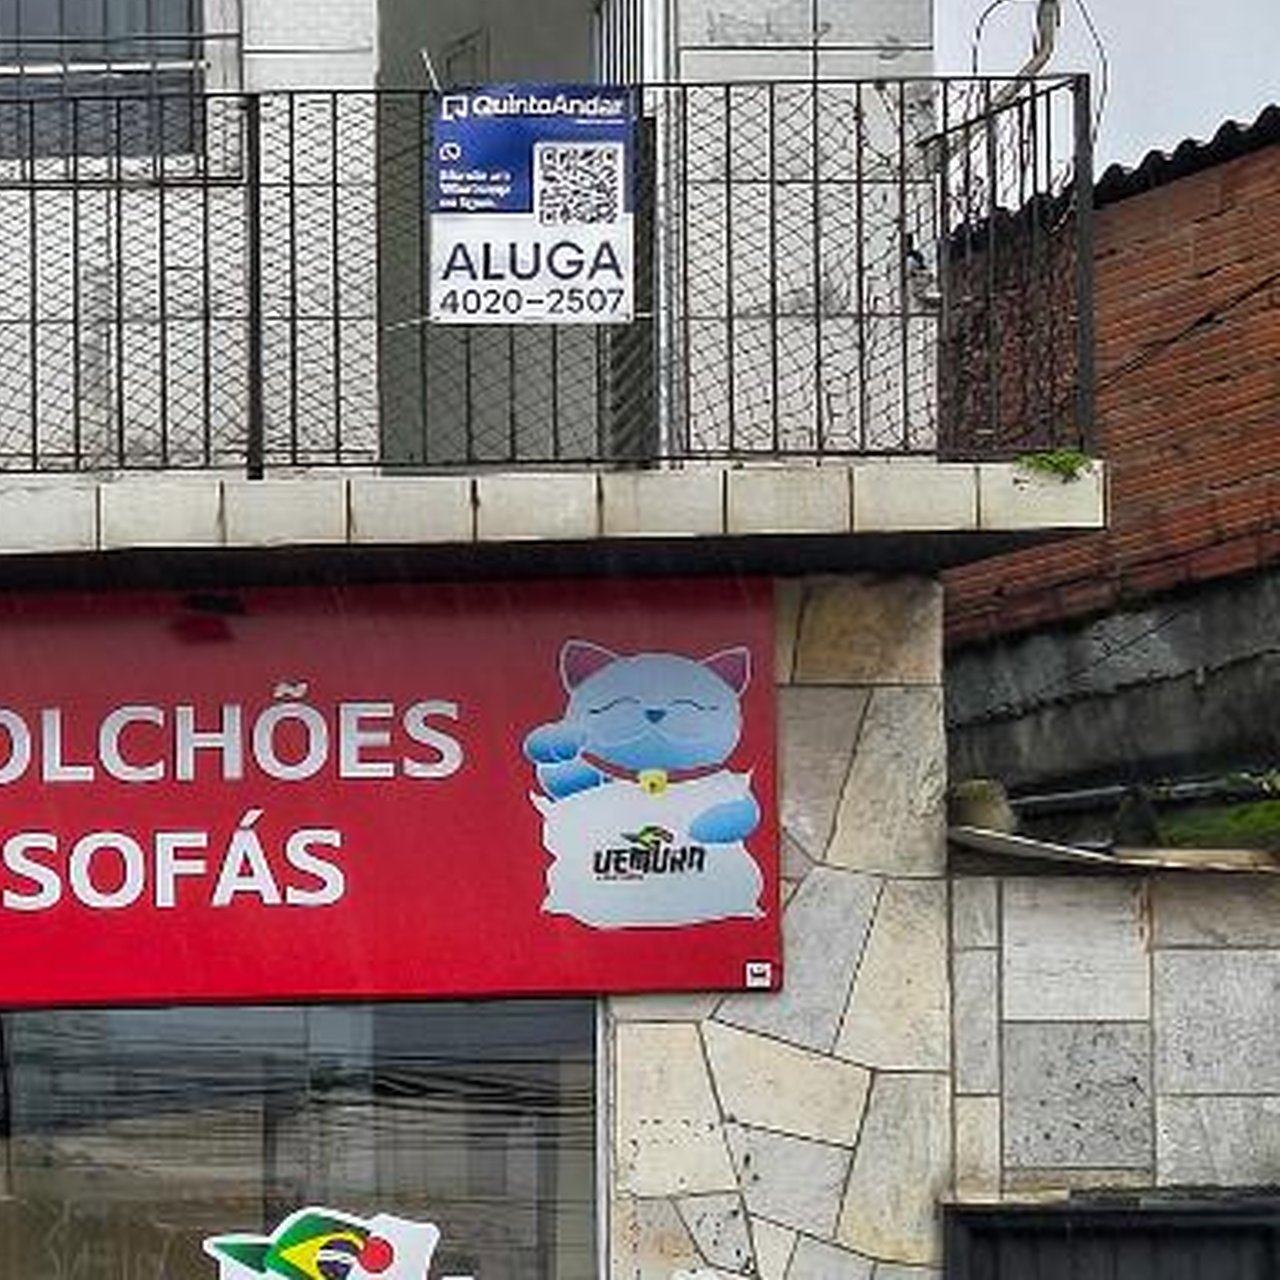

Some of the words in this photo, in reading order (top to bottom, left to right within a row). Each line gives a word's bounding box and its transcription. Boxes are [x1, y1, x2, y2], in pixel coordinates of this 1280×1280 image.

[472, 94, 625, 115] QuintaAndar
[441, 241, 624, 280] ALUGA
[440, 288, 625, 314] 4020-2507
[0, 810, 348, 911] SOFÁS
